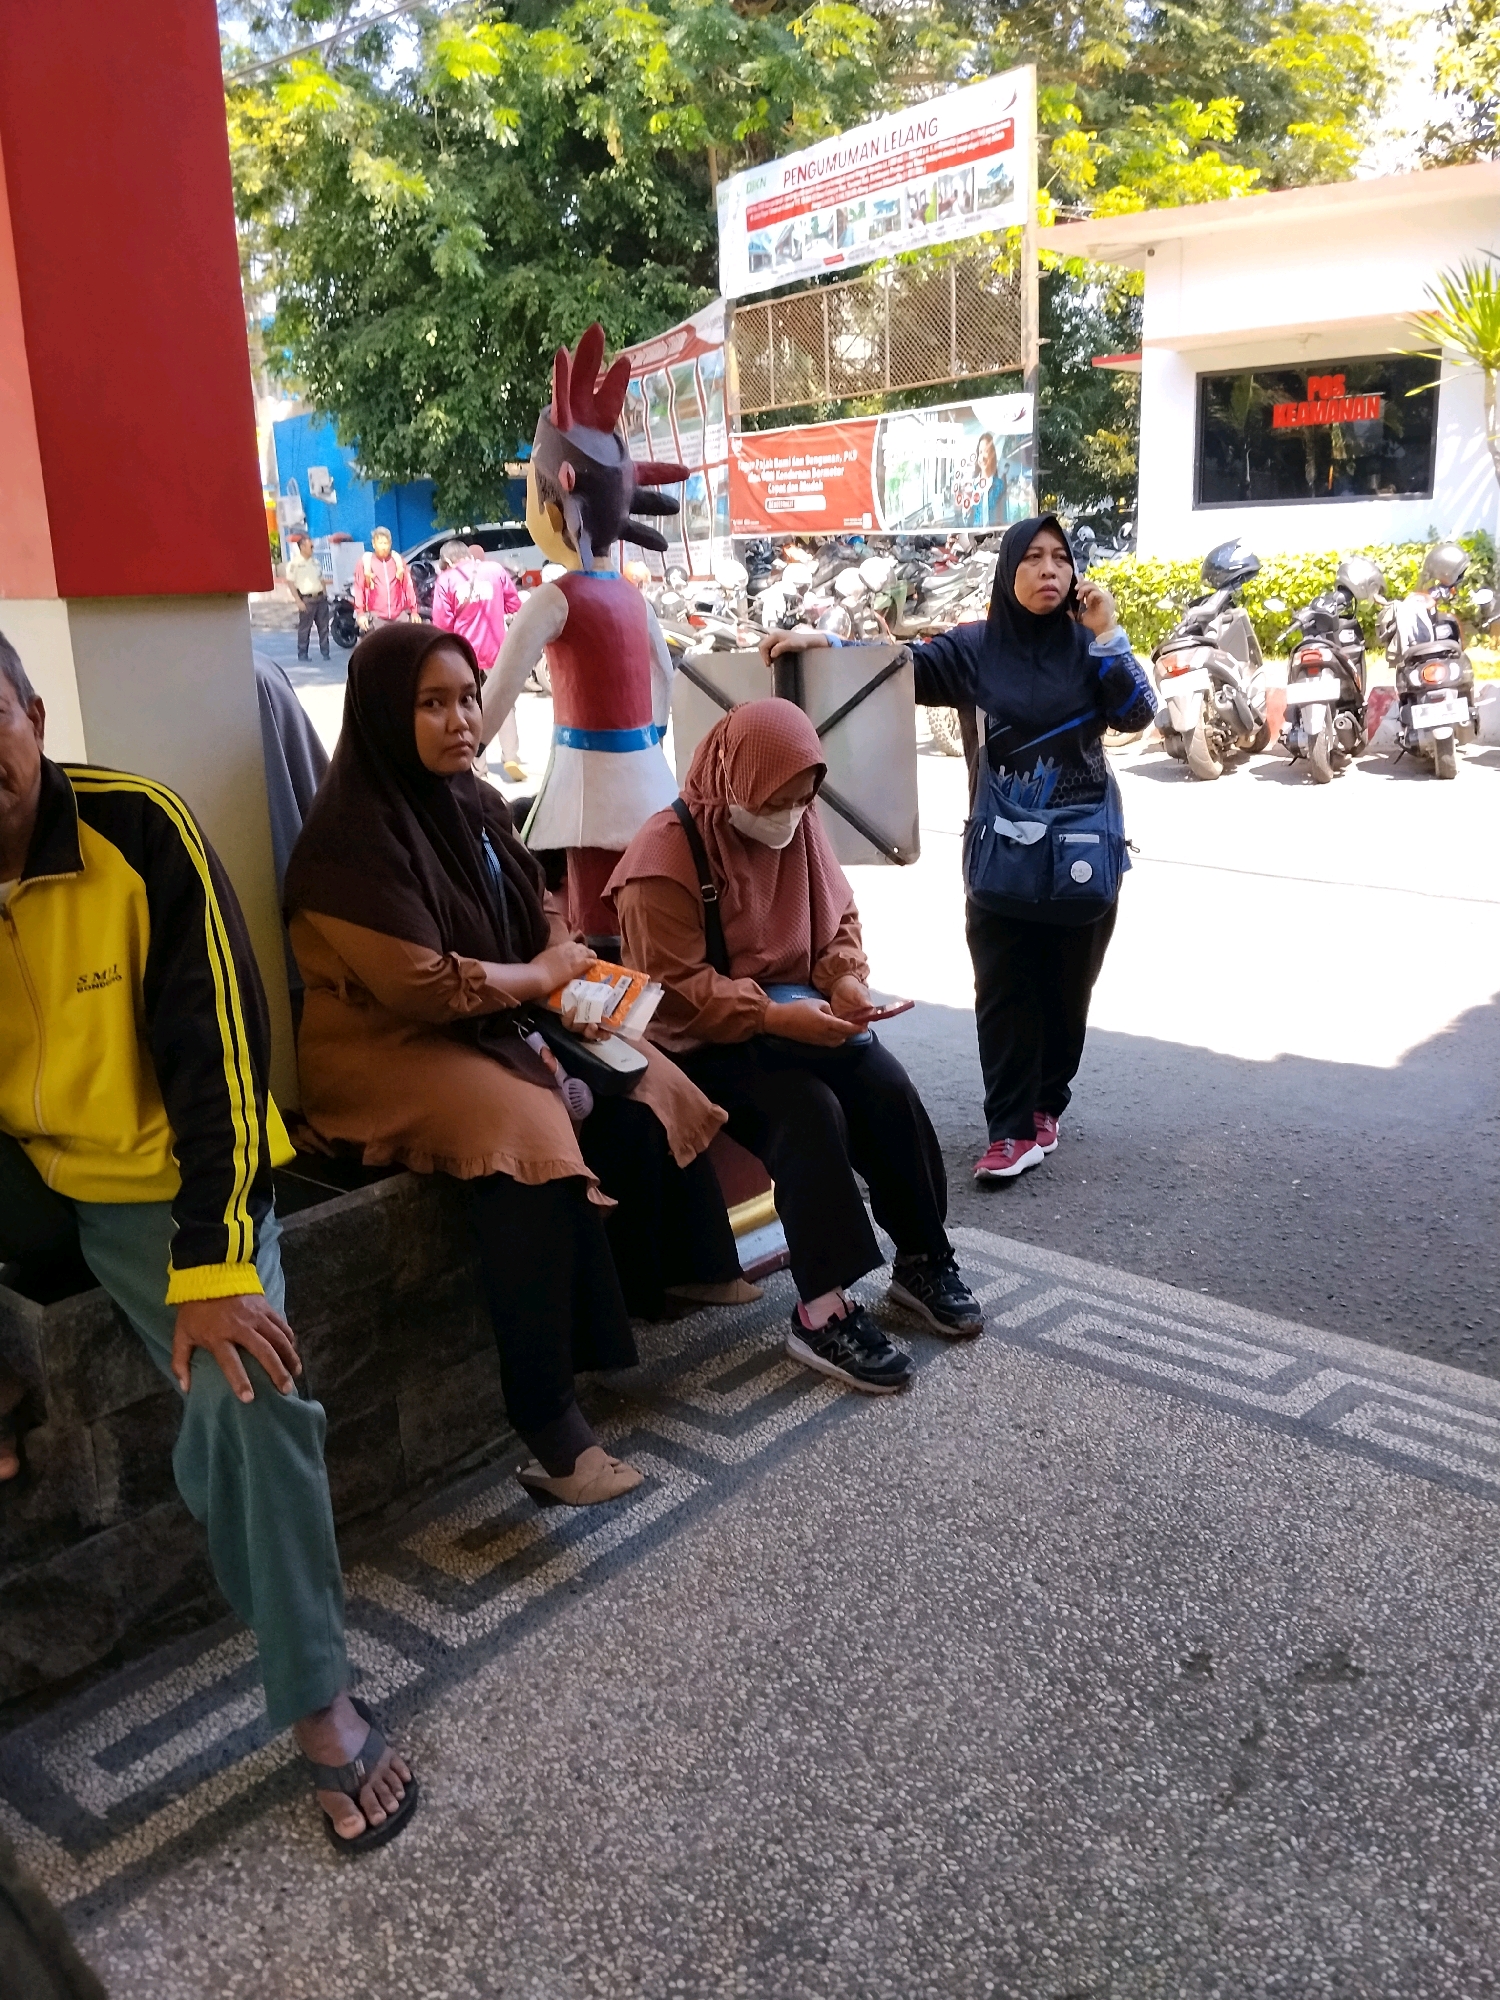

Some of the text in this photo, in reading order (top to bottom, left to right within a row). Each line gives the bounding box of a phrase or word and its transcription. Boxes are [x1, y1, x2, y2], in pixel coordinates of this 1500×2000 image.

[783, 137, 880, 188] PENGUMUMAN
[883, 117, 938, 153] LELANG
[1307, 374, 1346, 400] POS
[1272, 396, 1381, 428] KEAMANAN
[756, 458, 773, 471] Pajak
[775, 468, 811, 481] Kendaraan
[811, 466, 845, 479] Bermotor
